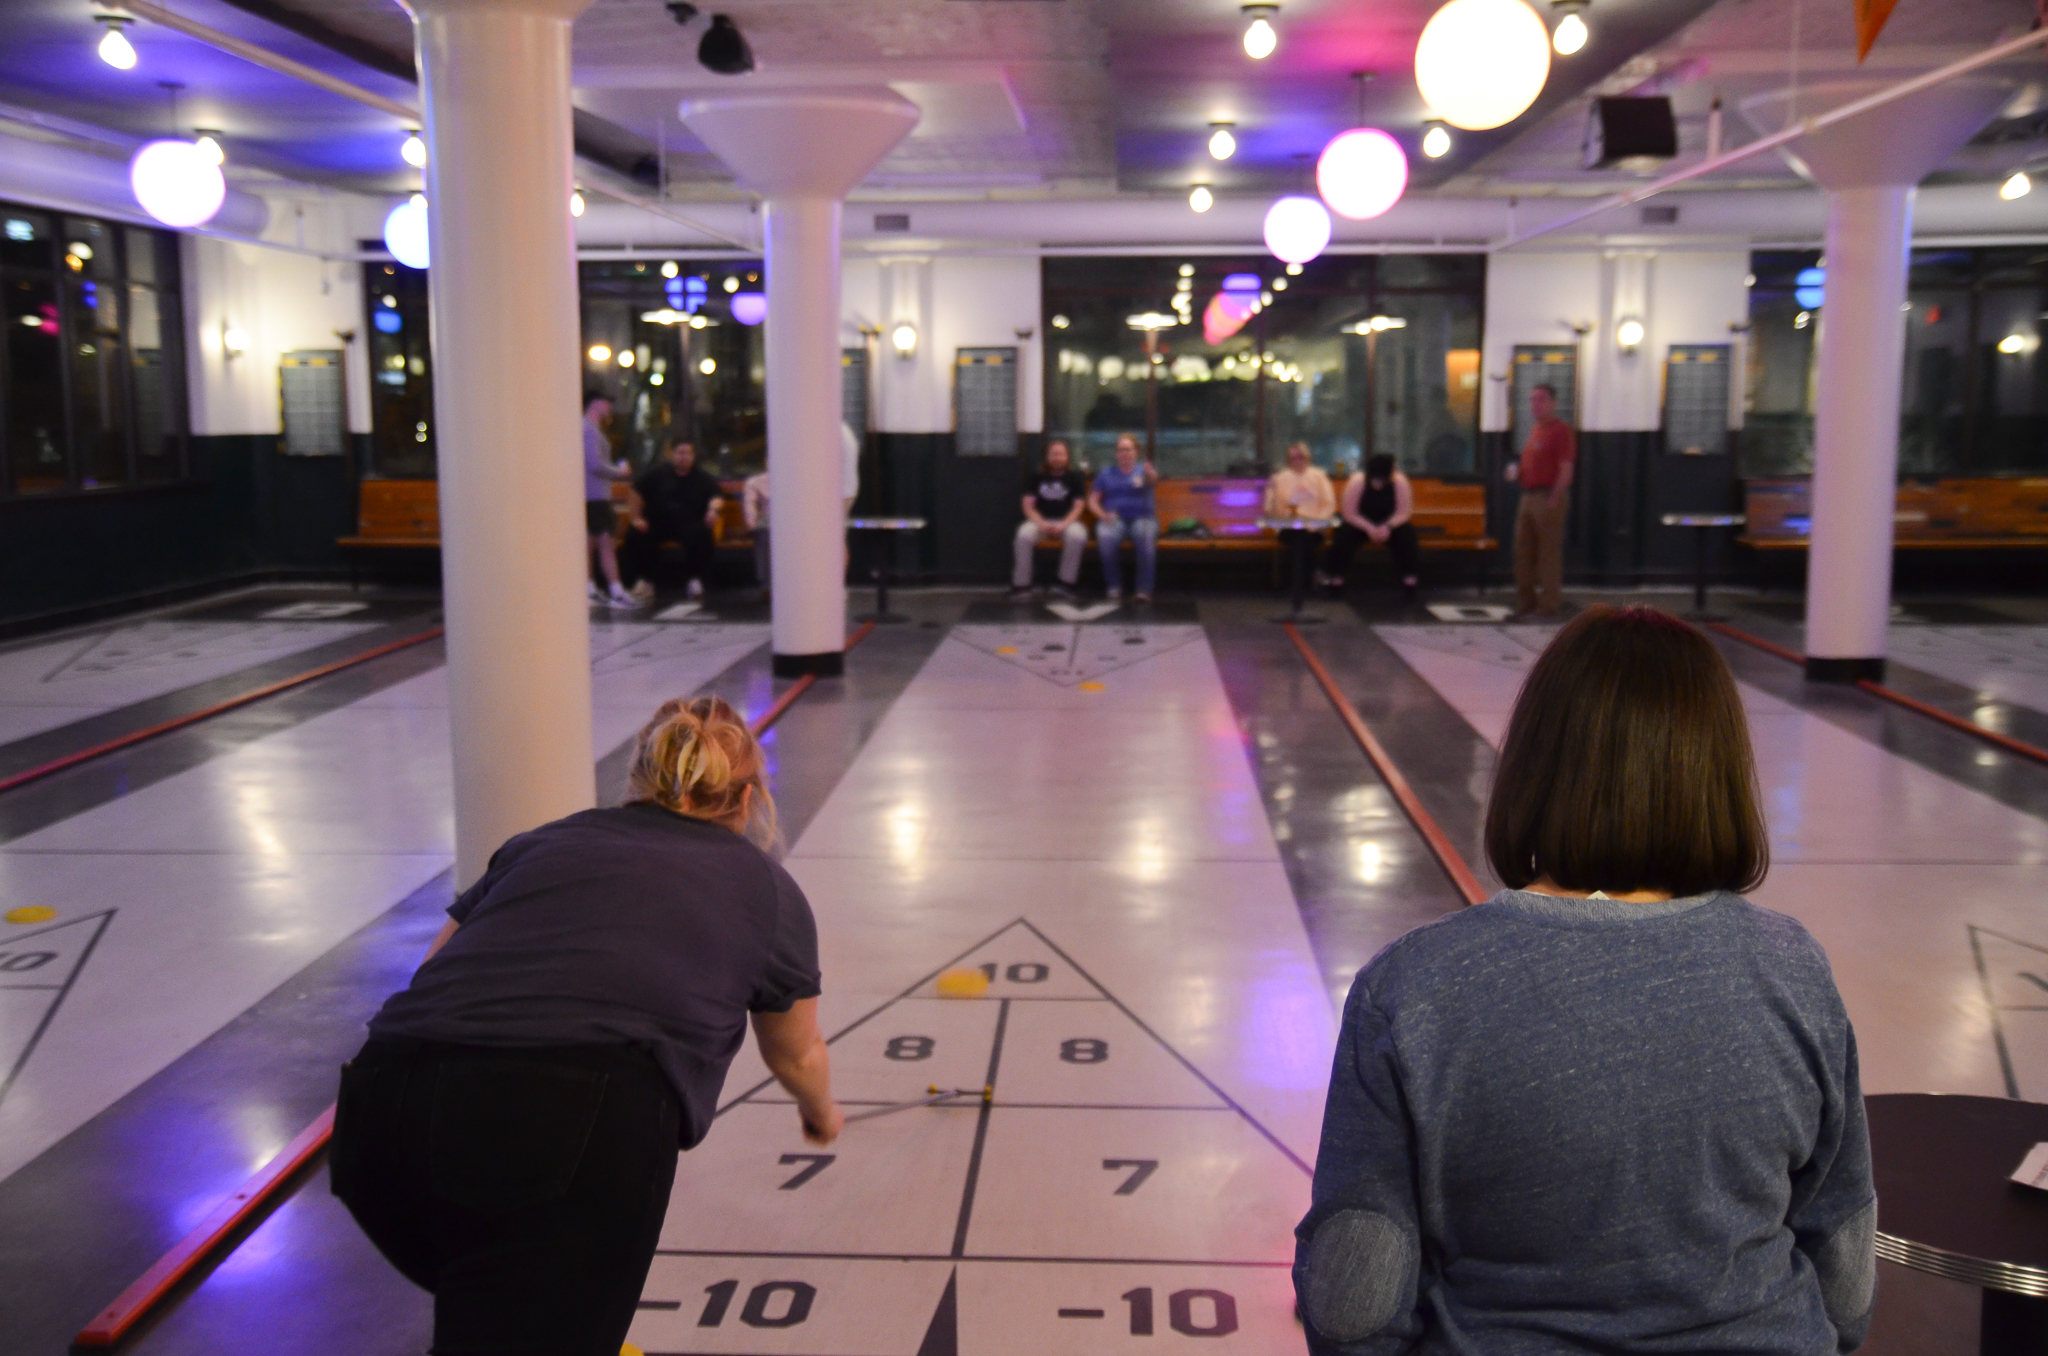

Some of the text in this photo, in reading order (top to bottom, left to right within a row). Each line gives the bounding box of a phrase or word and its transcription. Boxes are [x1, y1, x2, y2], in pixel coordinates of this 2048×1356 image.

[0, 952, 58, 971] 0
[979, 962, 1049, 983] 10
[884, 1035, 935, 1060] 8
[1059, 1038, 1108, 1063] 8
[777, 1154, 836, 1190] 7
[1102, 1159, 1158, 1195] 7
[637, 1279, 817, 1328] -10
[1058, 1287, 1239, 1337] -10
